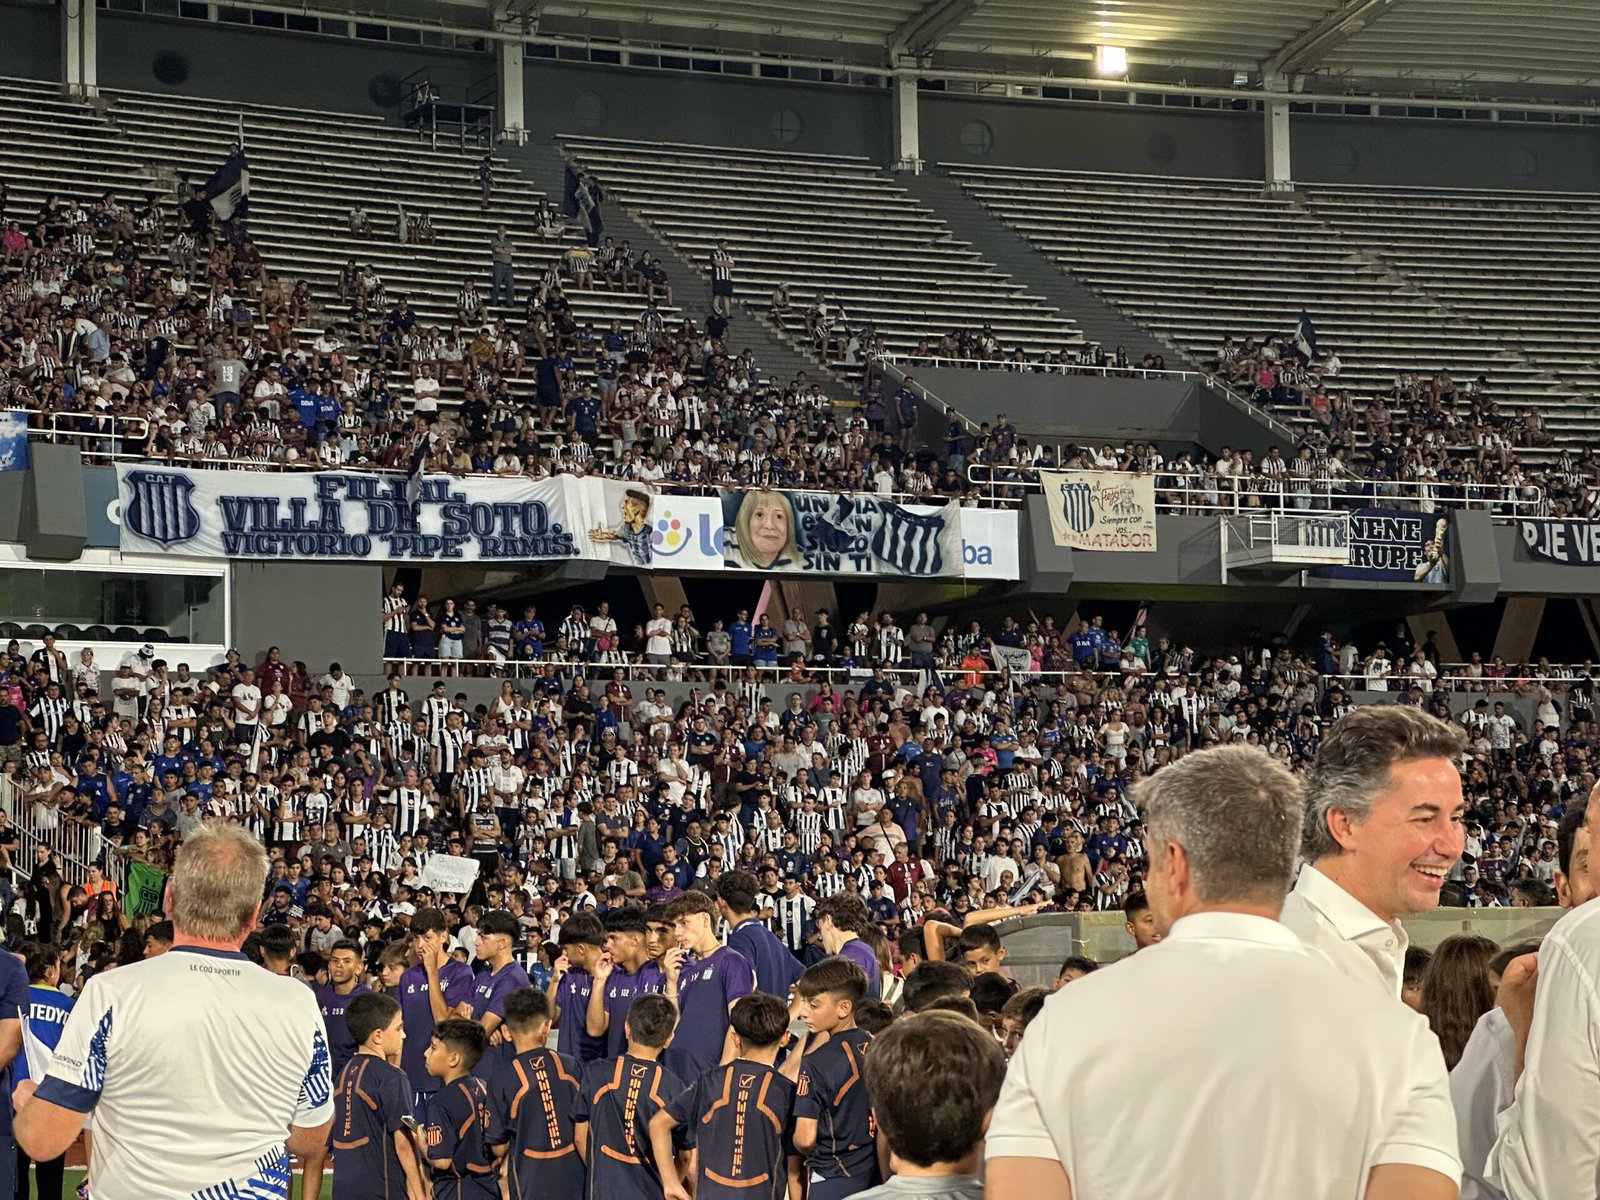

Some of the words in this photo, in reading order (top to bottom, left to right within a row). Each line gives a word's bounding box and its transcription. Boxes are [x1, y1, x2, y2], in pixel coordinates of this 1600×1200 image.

[794, 494, 830, 513] UN
[216, 495, 345, 533] VILLA
[366, 500, 421, 534] DE
[440, 500, 563, 537] SOTO.
[1100, 515, 1128, 526] Siempre
[1129, 516, 1142, 524] con
[1344, 516, 1422, 542] NENE
[220, 531, 372, 556] VICTORIO
[1079, 533, 1152, 548] MATADOR
[802, 551, 841, 571] SIN
[848, 553, 872, 572] TI
[199, 965, 213, 974] COQ
